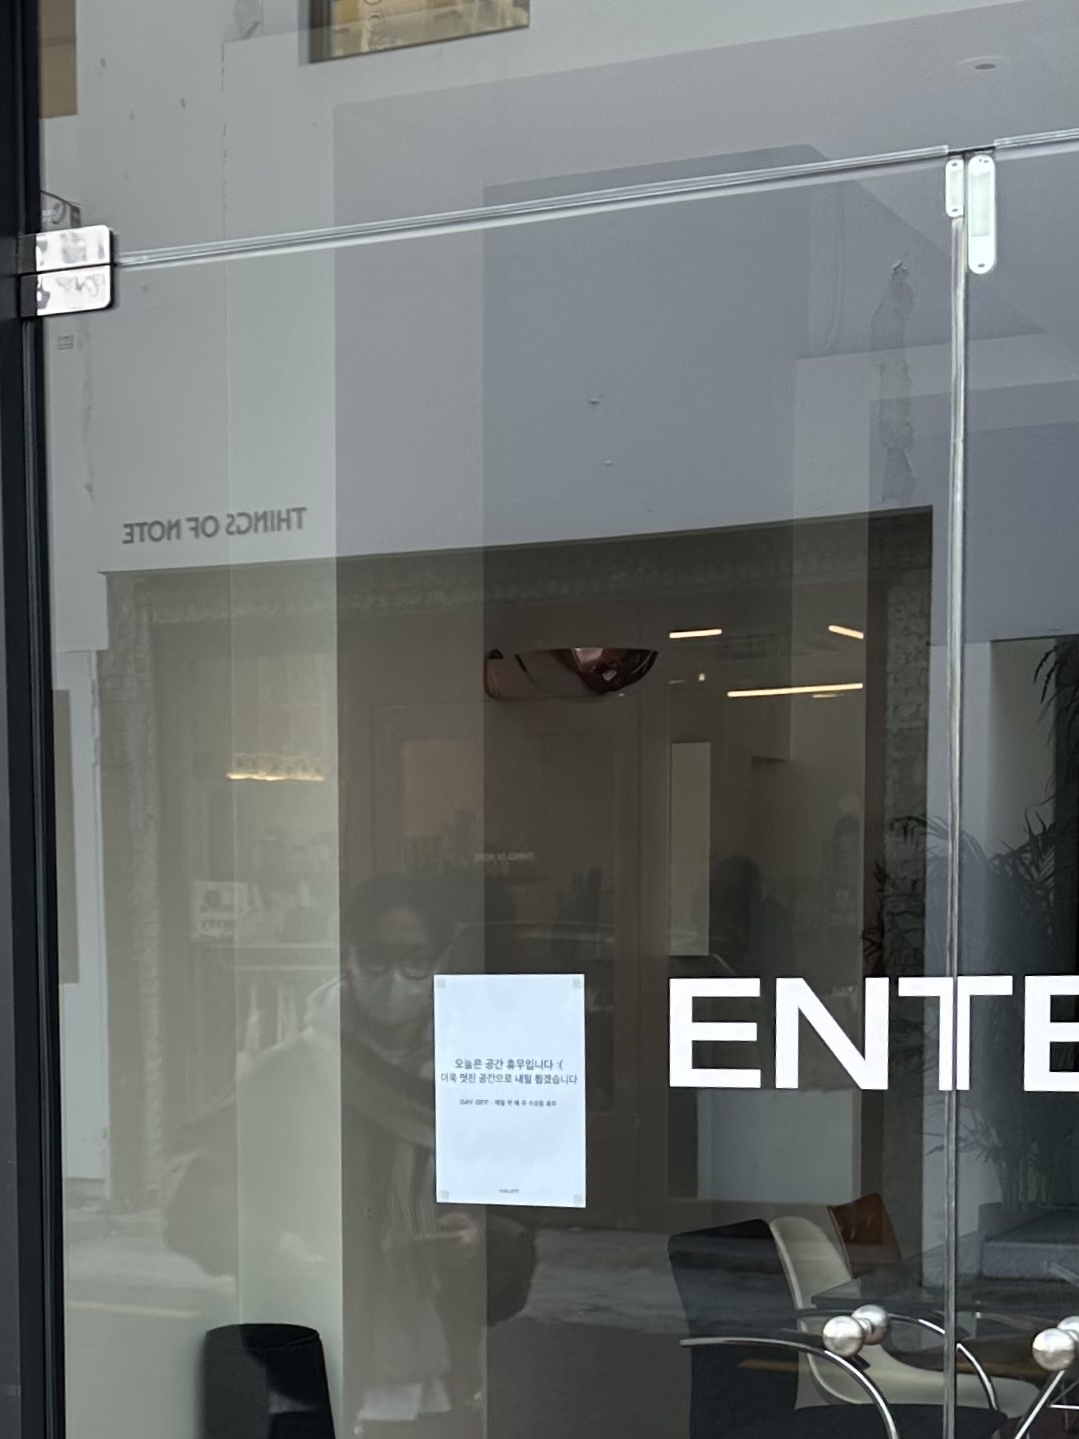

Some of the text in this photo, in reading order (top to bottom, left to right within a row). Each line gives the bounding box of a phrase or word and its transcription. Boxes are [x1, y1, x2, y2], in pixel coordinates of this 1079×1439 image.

[455, 1058, 482, 1070] 오늘은
[485, 1058, 504, 1070] 공간
[507, 1058, 554, 1070] 휴무입니다
[441, 1073, 578, 1085] 더욱 멋진 공간으로 내일 뵙겠습니다
